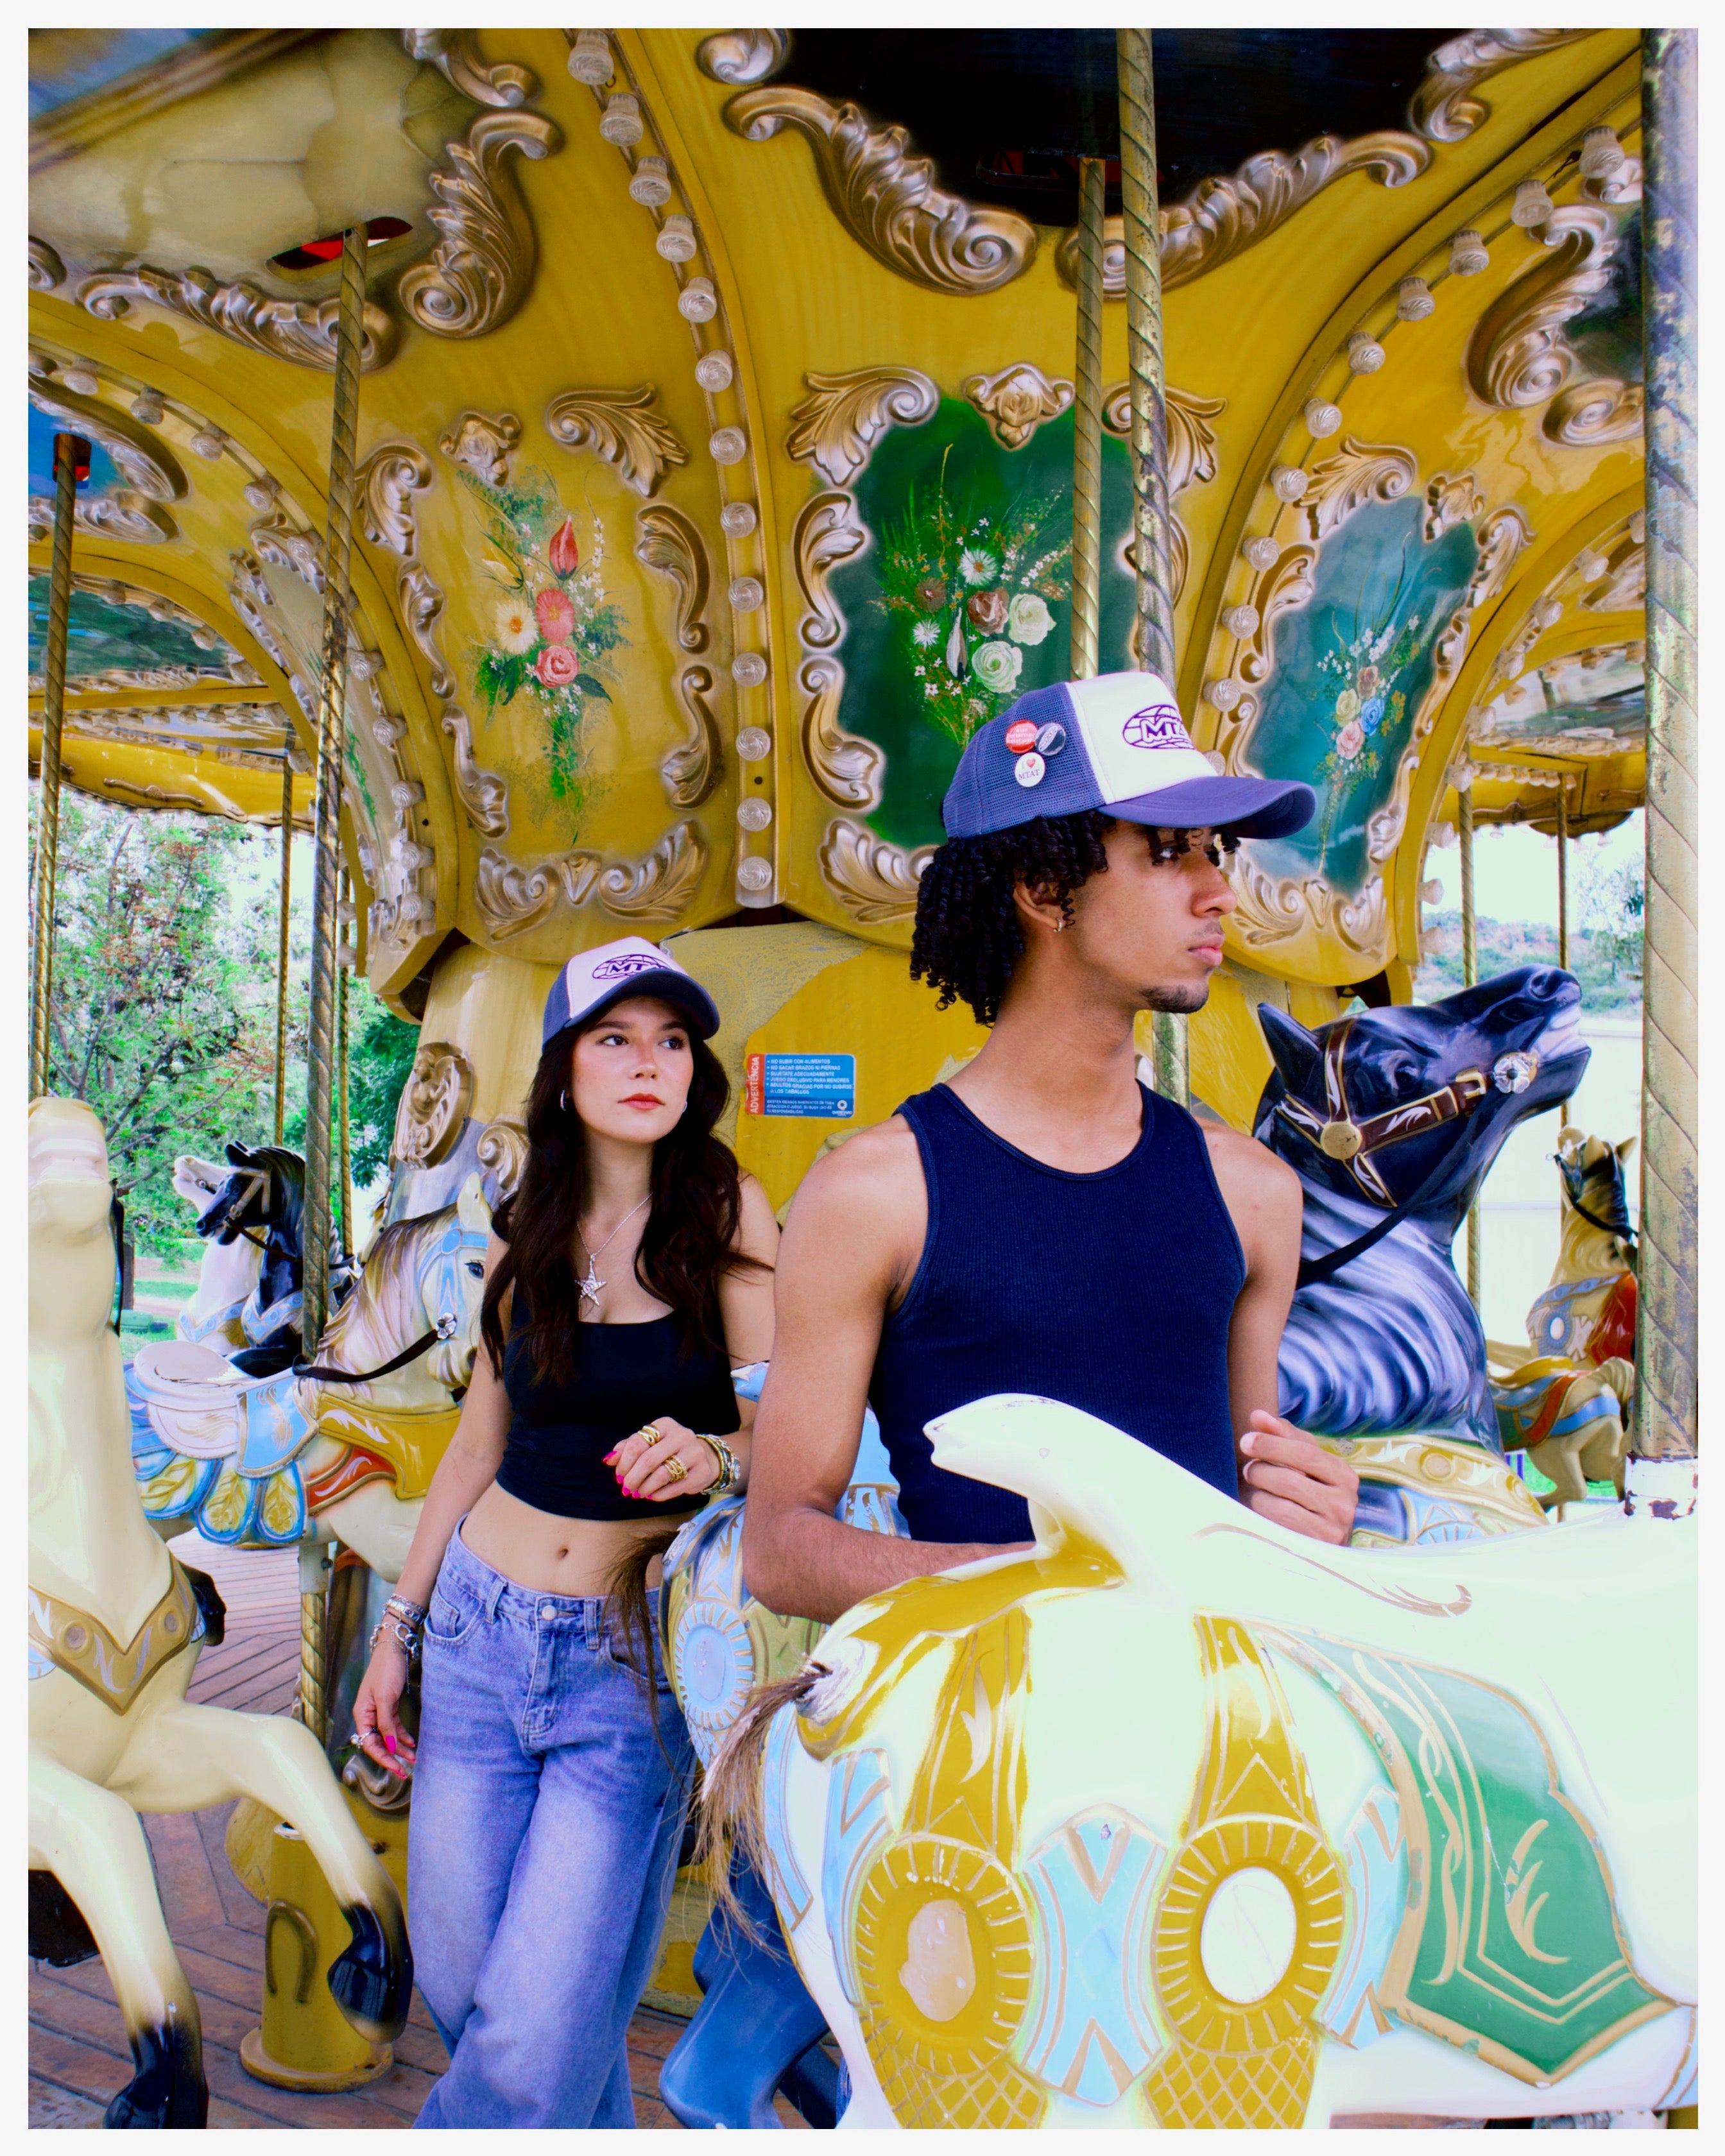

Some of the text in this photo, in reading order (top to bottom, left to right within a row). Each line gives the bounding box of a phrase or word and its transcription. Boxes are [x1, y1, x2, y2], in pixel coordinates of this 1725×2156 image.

[1142, 719, 1187, 740] MTA
[1018, 769, 1040, 780] MTAT
[750, 1056, 760, 1113] ADVERTENCIA
